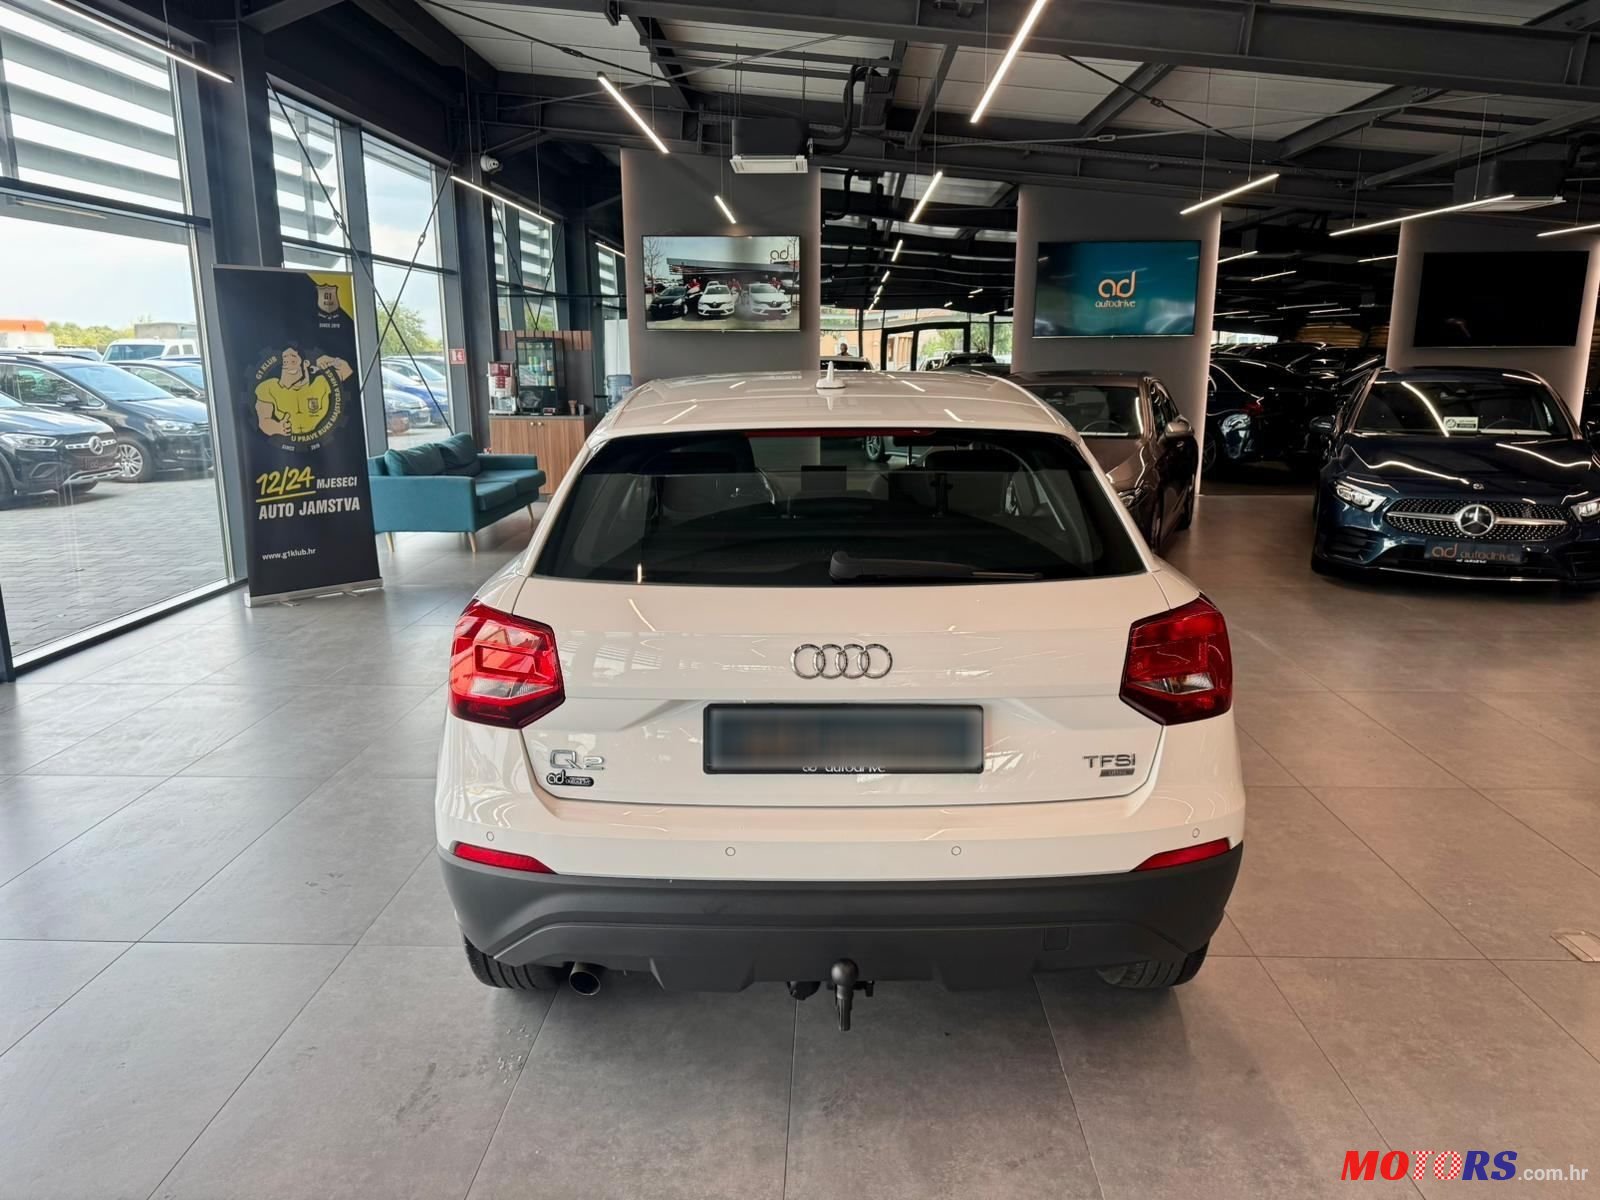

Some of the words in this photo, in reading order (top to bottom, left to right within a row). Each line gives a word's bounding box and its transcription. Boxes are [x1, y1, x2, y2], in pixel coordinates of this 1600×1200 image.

[1098, 270, 1136, 298] ad
[1095, 300, 1136, 308] autodrive
[261, 355, 278, 376] KLUB
[297, 432, 318, 442] PRAVE
[318, 420, 333, 436] RUKE
[255, 466, 316, 495] 12/24
[316, 476, 358, 489] MJESECI
[258, 502, 295, 520] AUTO
[298, 496, 360, 516] JAMSTVA
[262, 547, 316, 561] www.g1klub.hr
[1431, 543, 1459, 559] ad
[550, 749, 605, 770] Q2
[546, 769, 566, 785] ad
